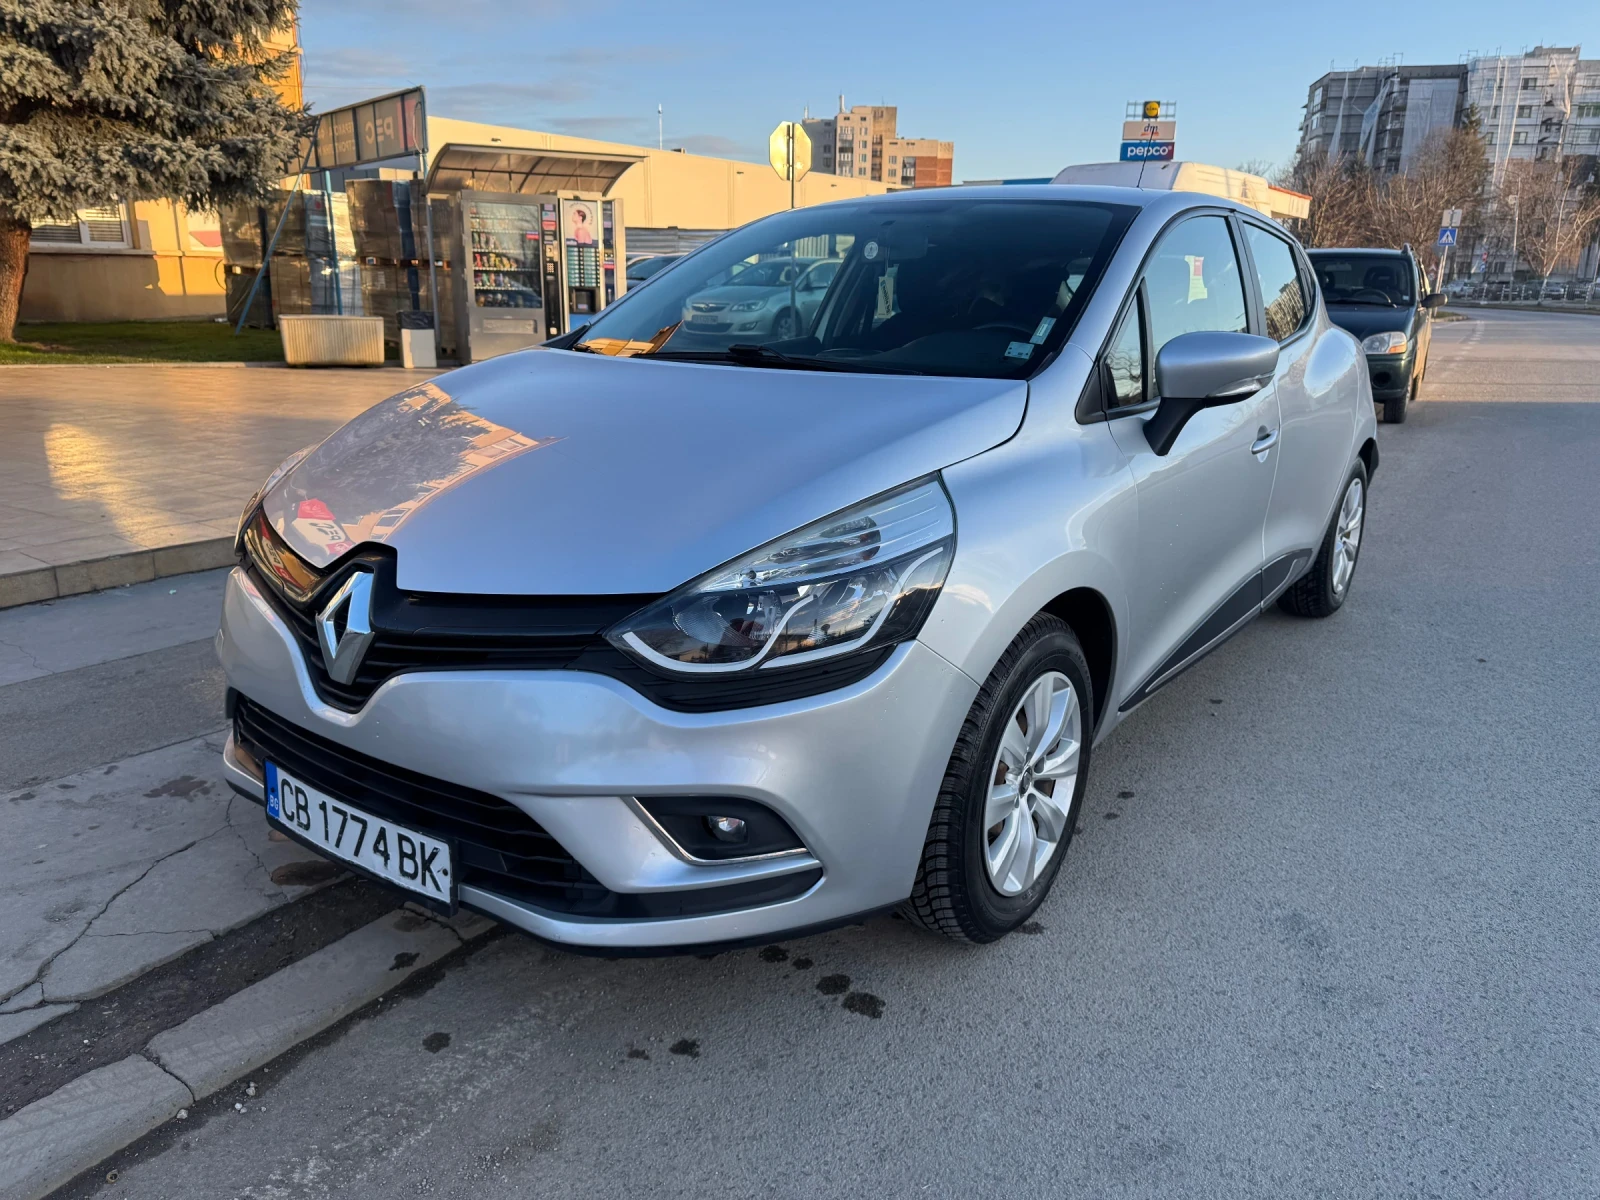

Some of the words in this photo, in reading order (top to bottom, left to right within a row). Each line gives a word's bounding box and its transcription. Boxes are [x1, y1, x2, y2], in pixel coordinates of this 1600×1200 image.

[1144, 123, 1158, 132] dm
[269, 794, 279, 811] BG
[281, 778, 311, 831] CB
[318, 801, 391, 870] 1774
[397, 832, 443, 893] BK
